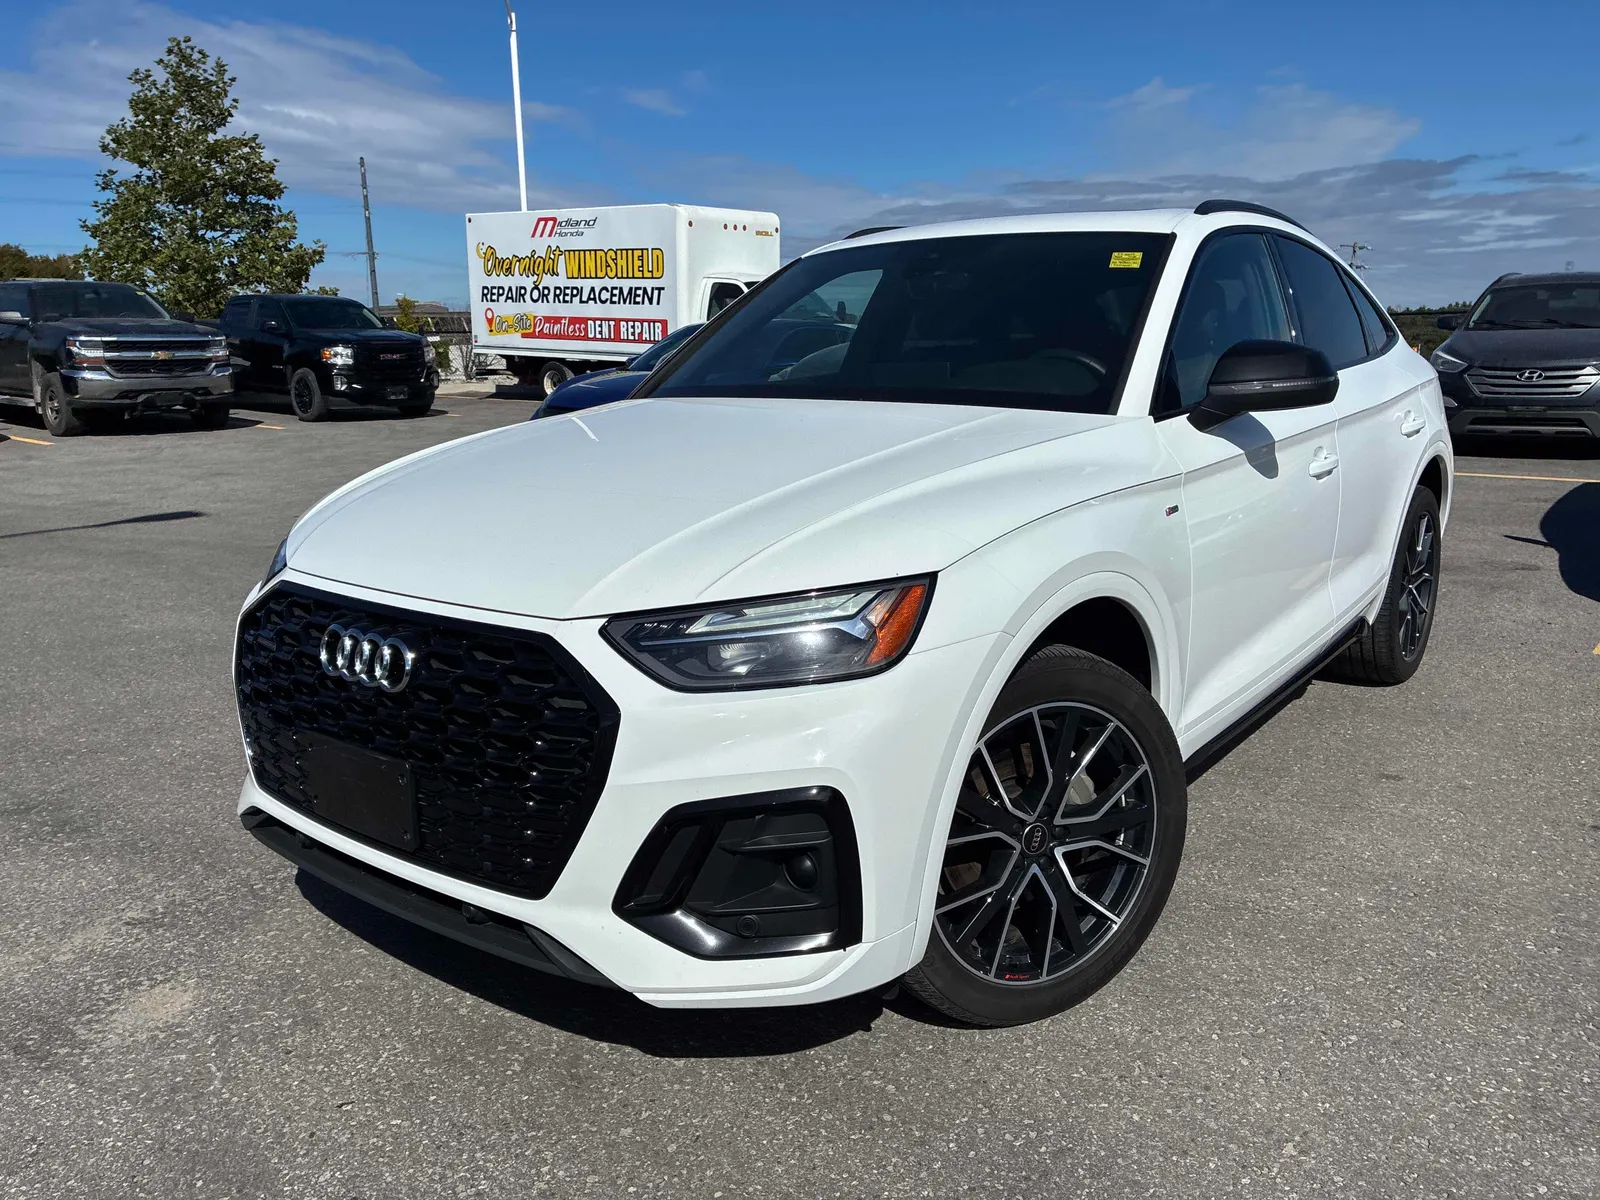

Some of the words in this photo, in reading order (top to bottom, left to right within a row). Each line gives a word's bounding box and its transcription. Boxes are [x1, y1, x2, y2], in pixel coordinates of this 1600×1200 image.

[531, 216, 598, 238] Midland
[483, 245, 563, 286] Overnight
[564, 248, 665, 279] WINDSHIELD
[481, 285, 527, 304] REPAIR
[530, 285, 551, 304] OR
[553, 286, 665, 305] REPLACEMENT
[494, 313, 532, 334] On-Site
[535, 316, 585, 337] Paintless
[587, 320, 616, 339] DENT
[620, 321, 662, 342] REPAIR
